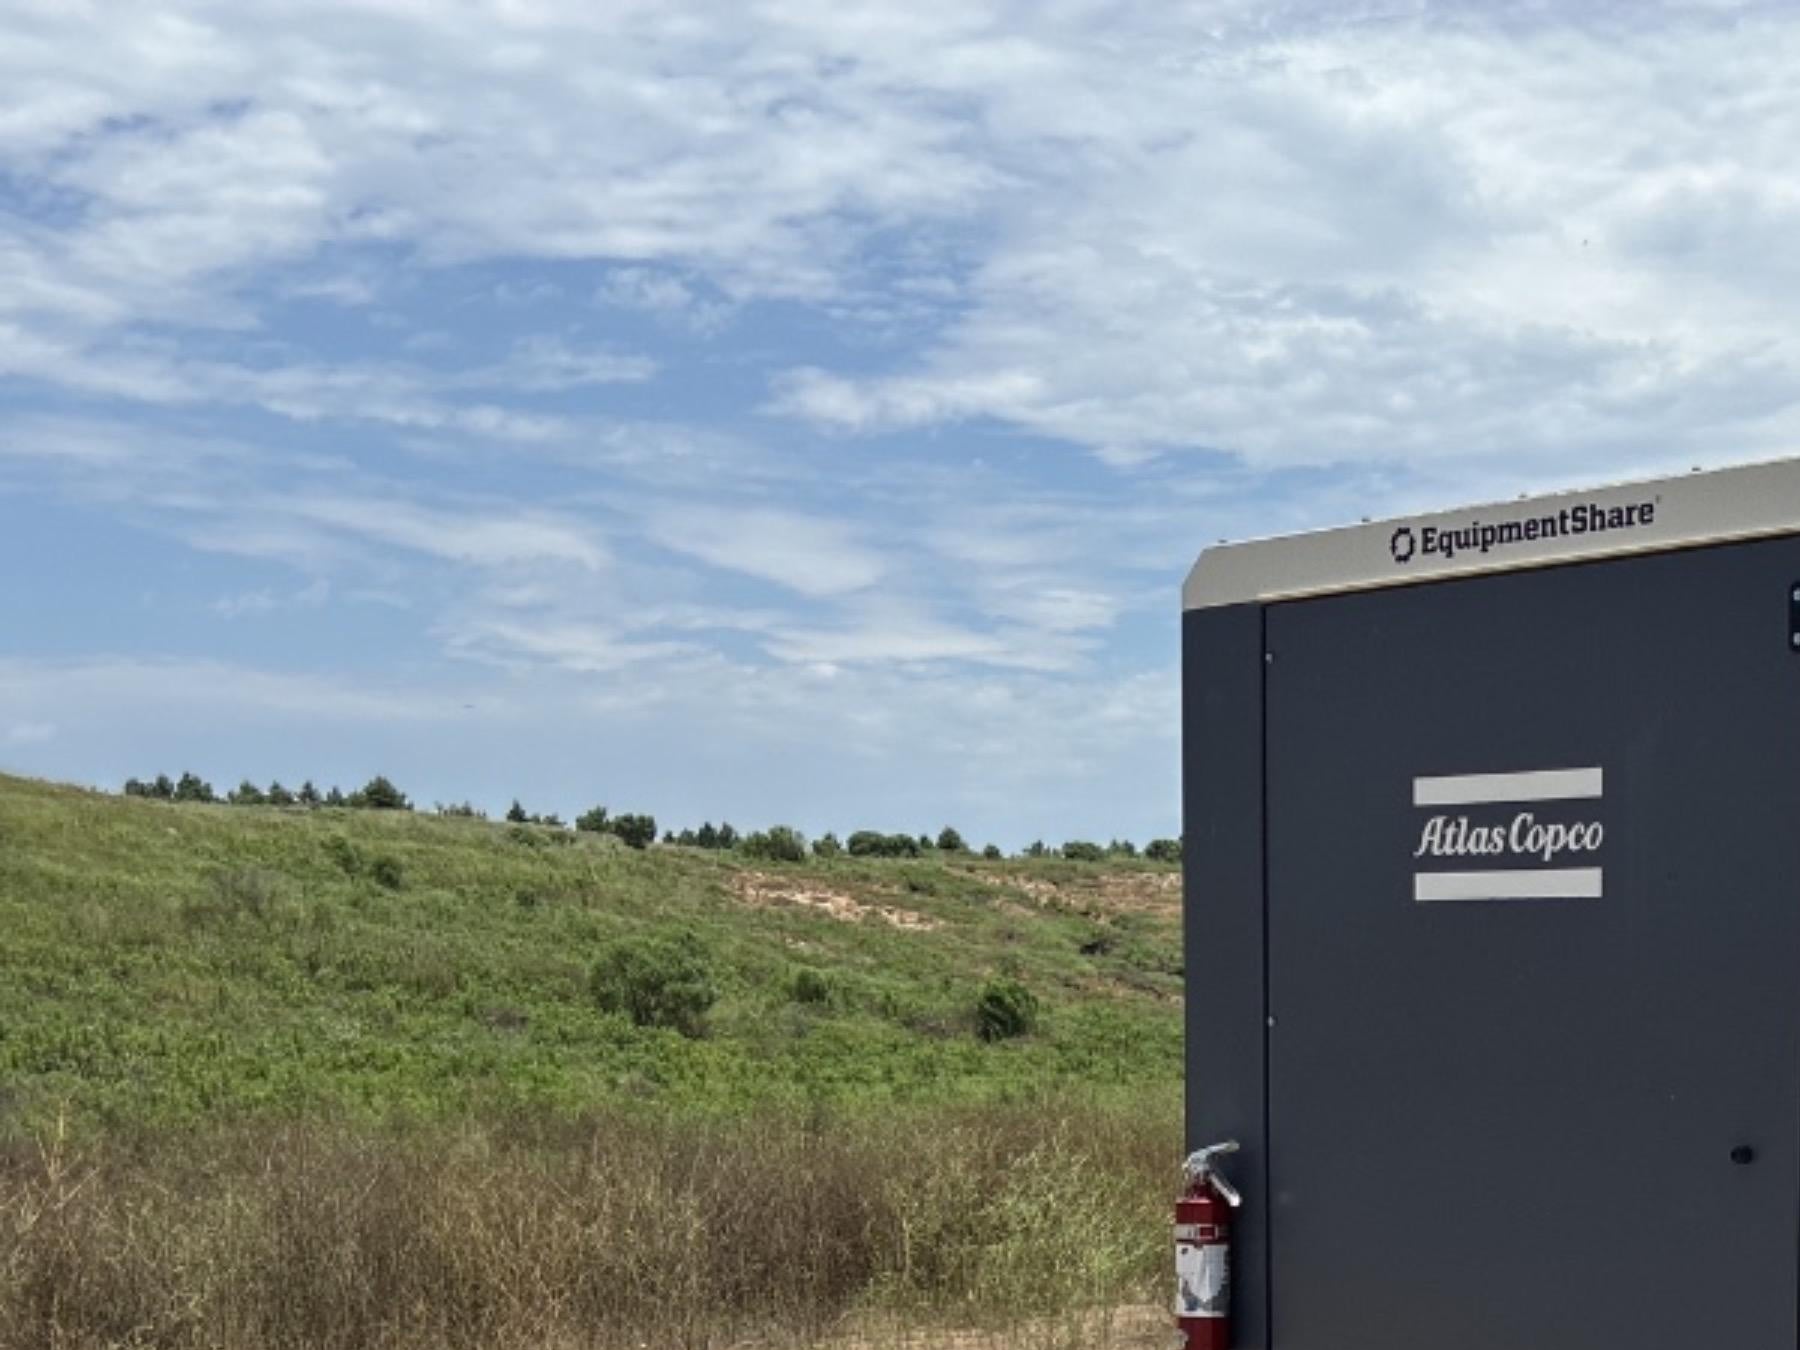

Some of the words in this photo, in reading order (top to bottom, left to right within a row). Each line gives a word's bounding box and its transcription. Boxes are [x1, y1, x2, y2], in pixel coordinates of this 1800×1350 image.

[1421, 503, 1655, 558] EquipmentShare
[1413, 814, 1506, 858] Atlas
[1508, 811, 1604, 863] Copco
